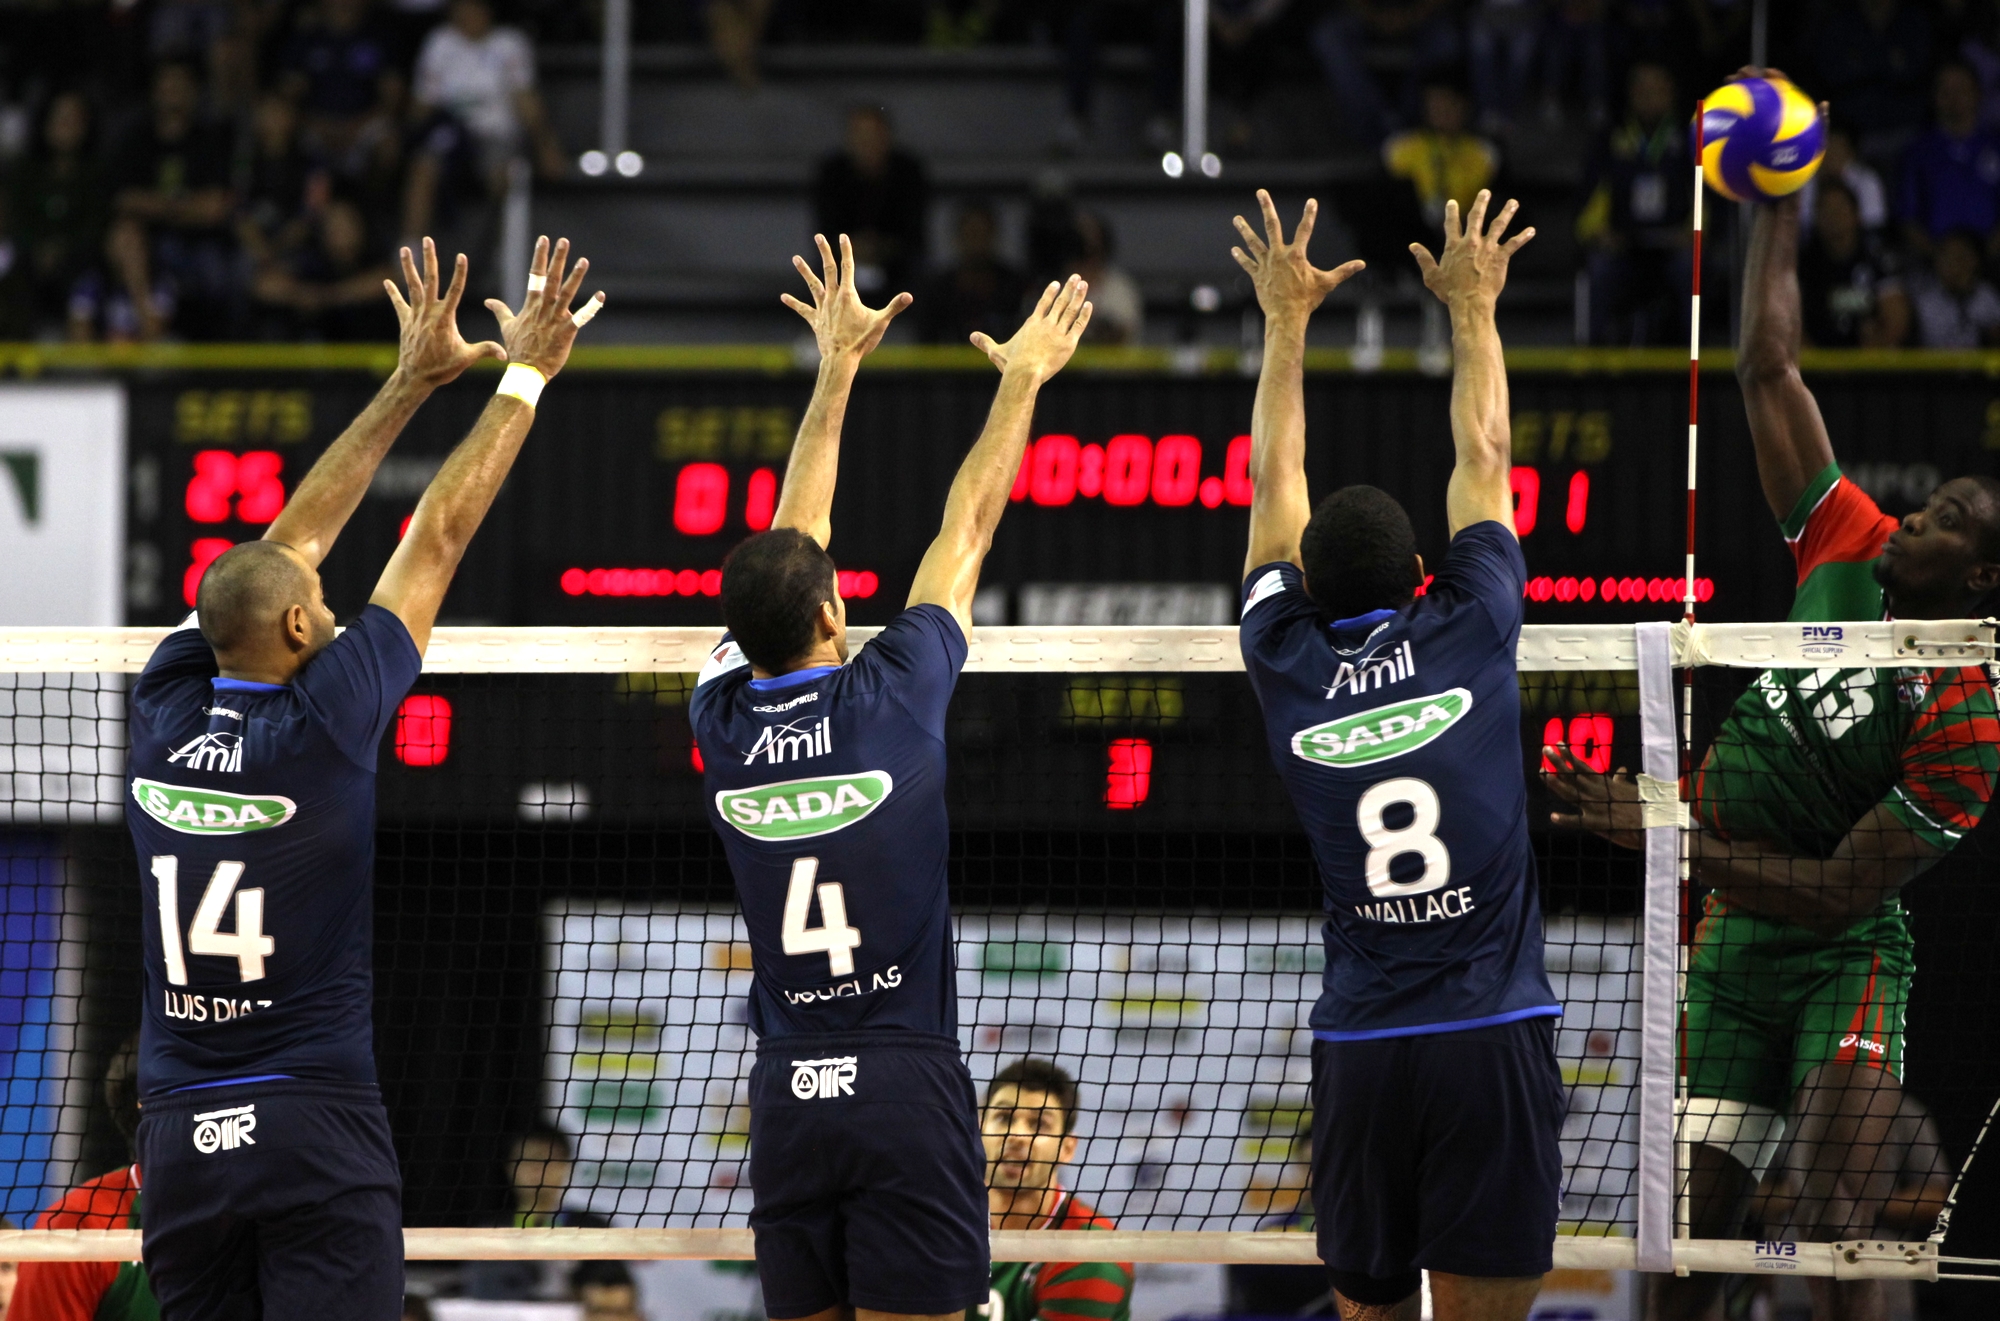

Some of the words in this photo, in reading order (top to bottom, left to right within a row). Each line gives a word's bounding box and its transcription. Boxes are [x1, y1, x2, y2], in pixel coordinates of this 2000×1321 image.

[1802, 627, 1843, 640] FIVB
[1322, 640, 1415, 699] Amil
[168, 732, 243, 772] Amil
[742, 716, 832, 765] Amil
[1311, 703, 1452, 757] SADA
[146, 787, 273, 827] SADA
[730, 783, 873, 825] SADA
[1356, 776, 1451, 898] 8
[151, 855, 275, 986] 14
[781, 856, 862, 977] 4
[164, 989, 208, 1022] LUIS
[1755, 1240, 1796, 1256] FIVB
